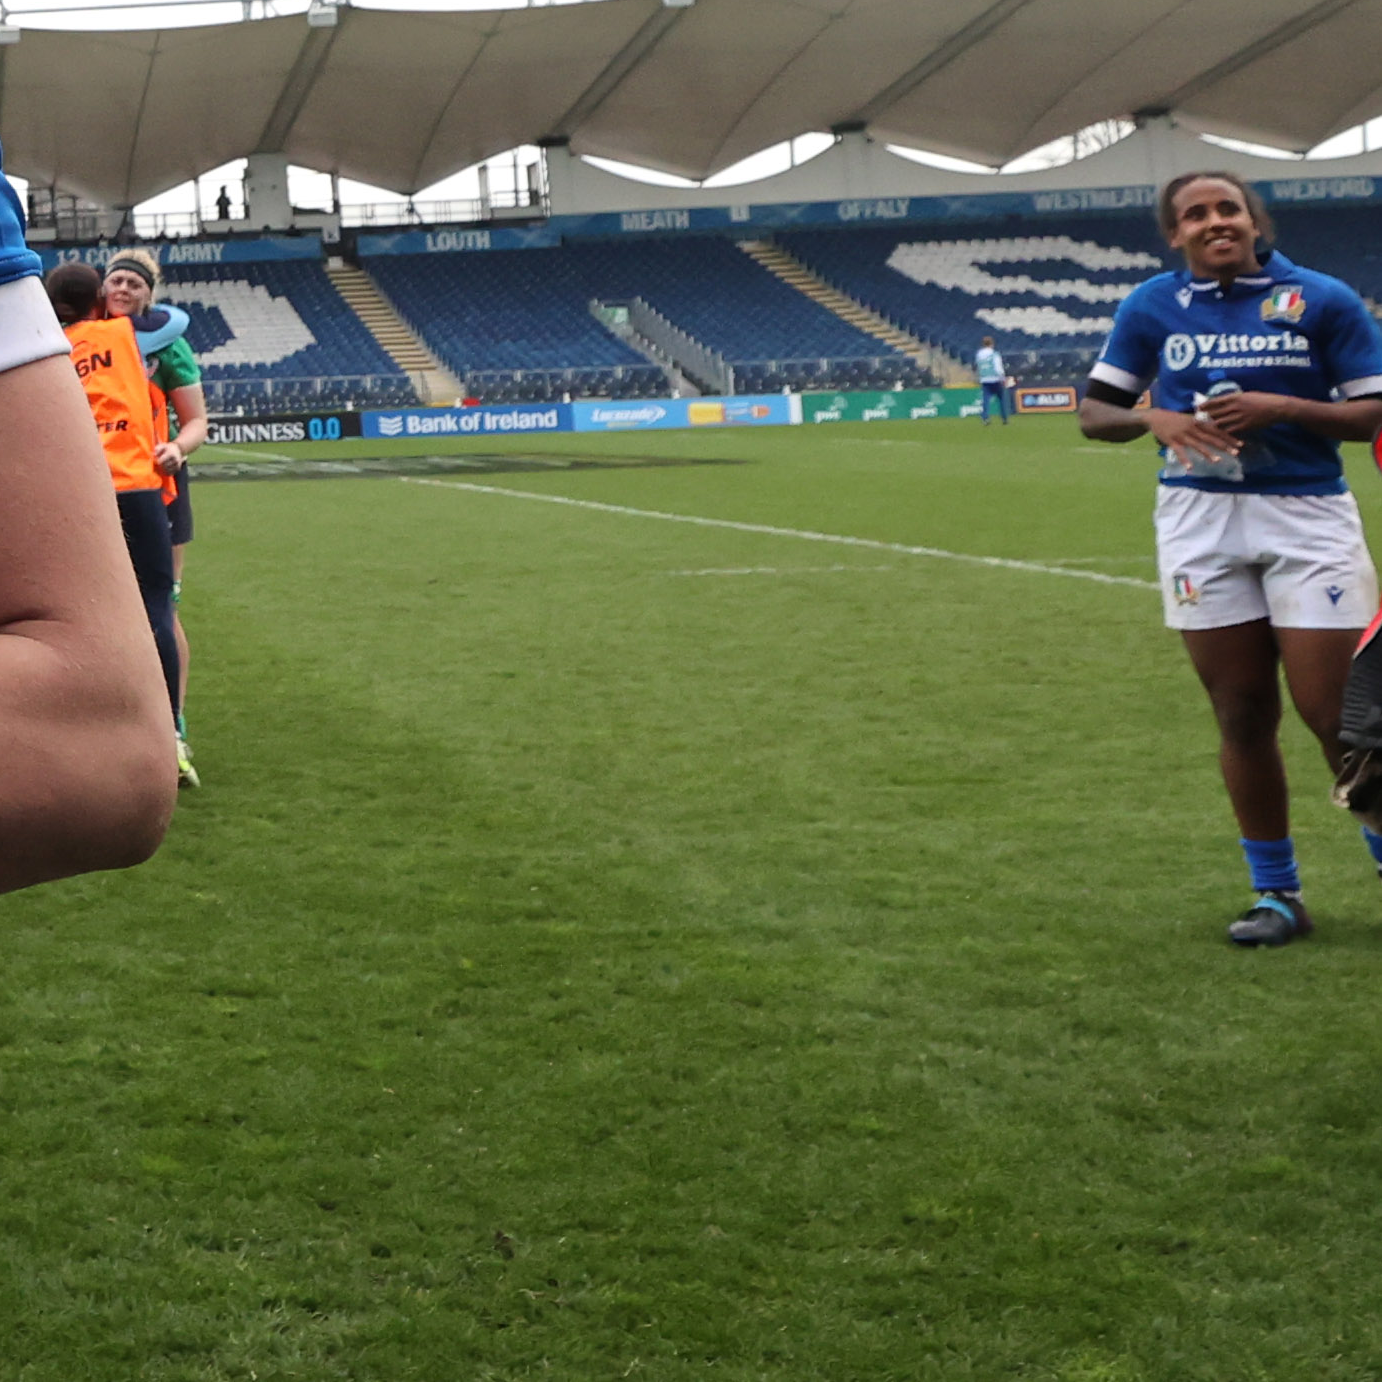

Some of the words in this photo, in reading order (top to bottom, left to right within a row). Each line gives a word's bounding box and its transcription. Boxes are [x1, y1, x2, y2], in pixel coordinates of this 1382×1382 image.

[621, 211, 690, 231] MEATH
[426, 231, 492, 251] LOUTH
[168, 244, 227, 264] ARMY
[1194, 331, 1310, 354] Vittoria
[204, 422, 306, 444] GUINNESS
[309, 417, 341, 441] 0.0
[407, 414, 458, 434] Bank
[459, 412, 482, 431] of
[485, 409, 558, 430] Ireland
